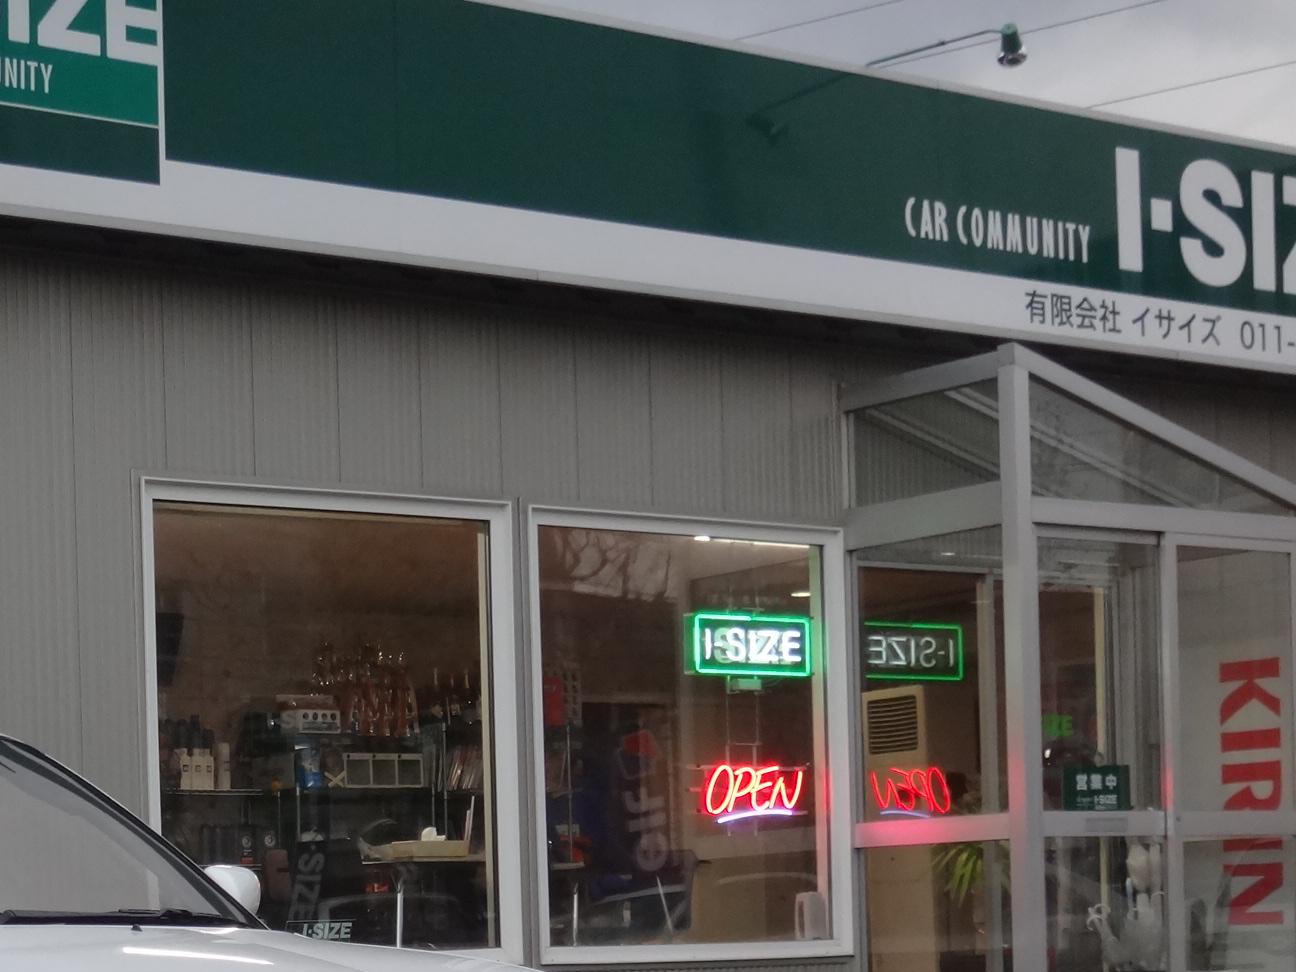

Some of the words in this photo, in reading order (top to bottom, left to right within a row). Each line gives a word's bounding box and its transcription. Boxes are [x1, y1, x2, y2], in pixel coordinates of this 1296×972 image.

[904, 196, 948, 242] CAR
[956, 205, 1091, 263] COMMUNITY
[1115, 145, 1296, 295] I-SI
[1025, 289, 1122, 335] 有限会社
[1132, 306, 1222, 347] イサイズ
[704, 627, 802, 663] I-SIZE
[705, 764, 803, 815] OPEN
[1218, 656, 1285, 927] KIRIN
